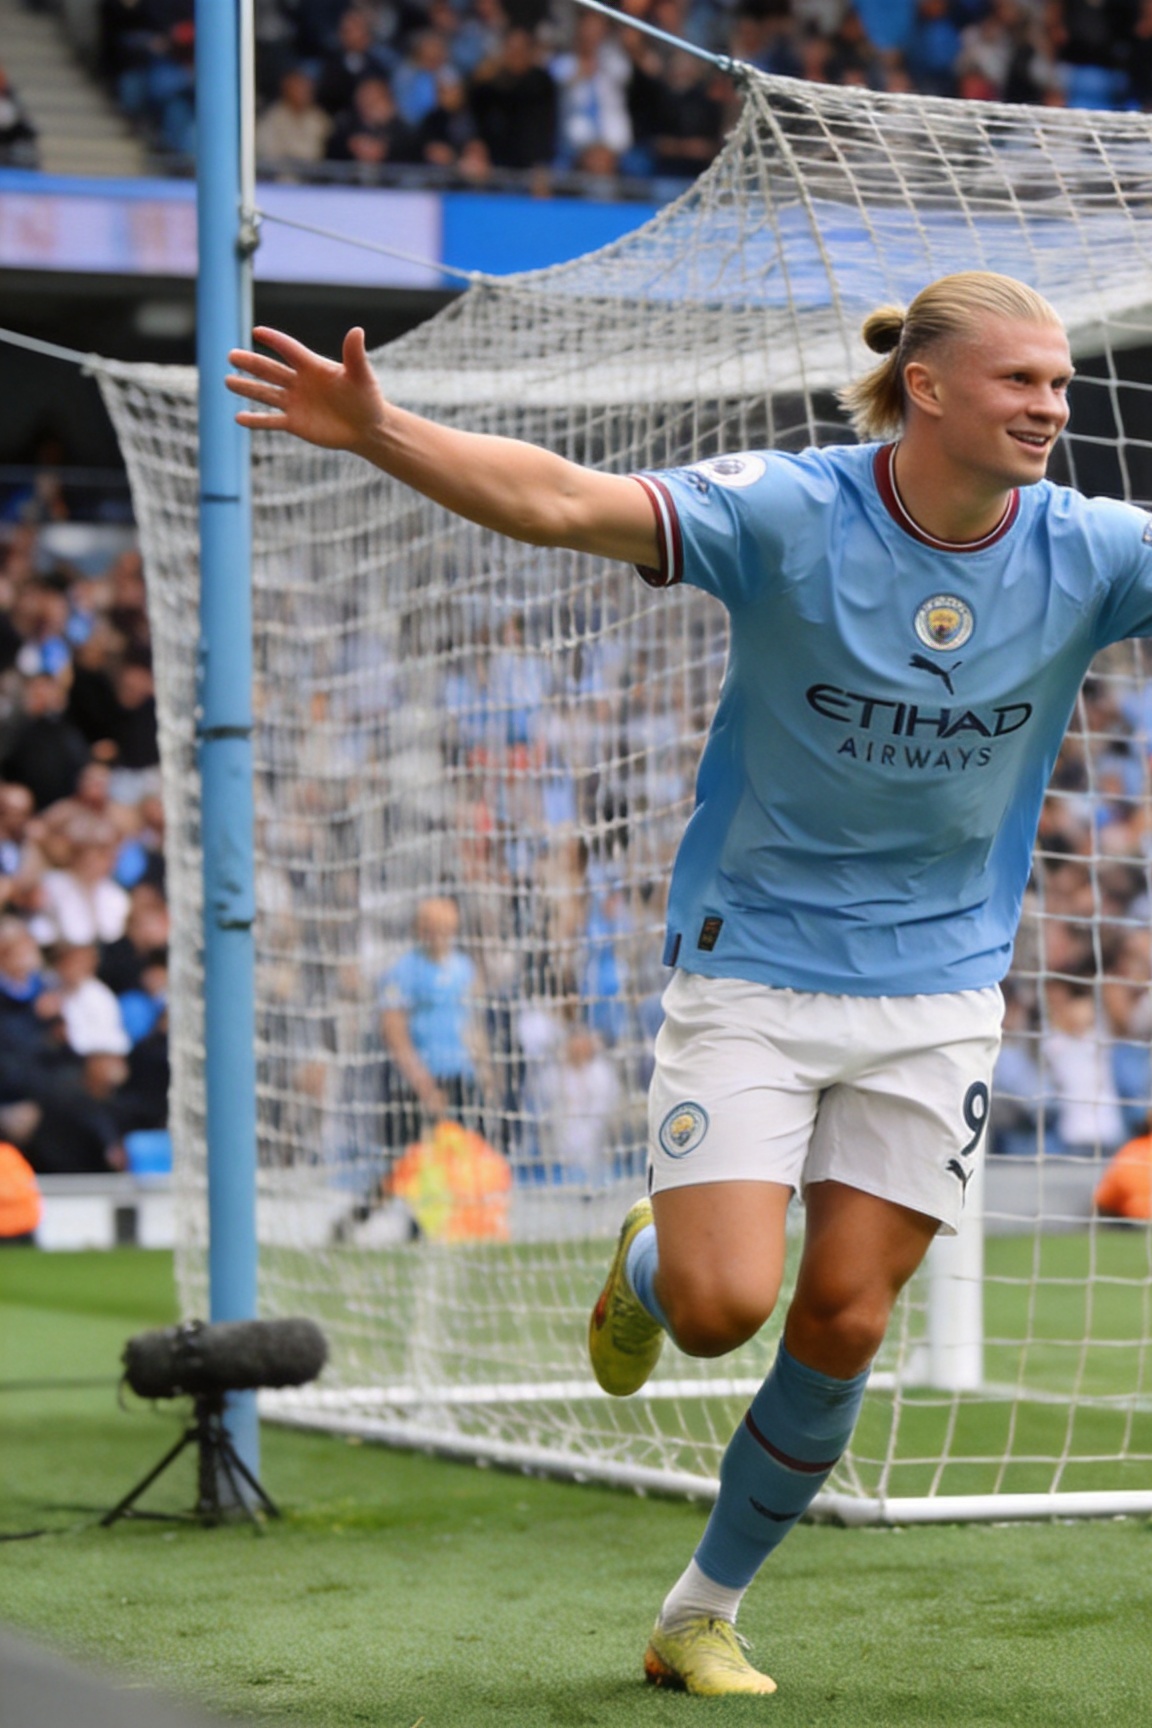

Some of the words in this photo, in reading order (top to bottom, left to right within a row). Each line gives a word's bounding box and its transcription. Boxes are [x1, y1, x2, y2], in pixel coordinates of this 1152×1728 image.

[806, 683, 1033, 738] ETIHAD
[837, 737, 992, 771] AIRWAYS
[961, 1080, 989, 1157] 9
